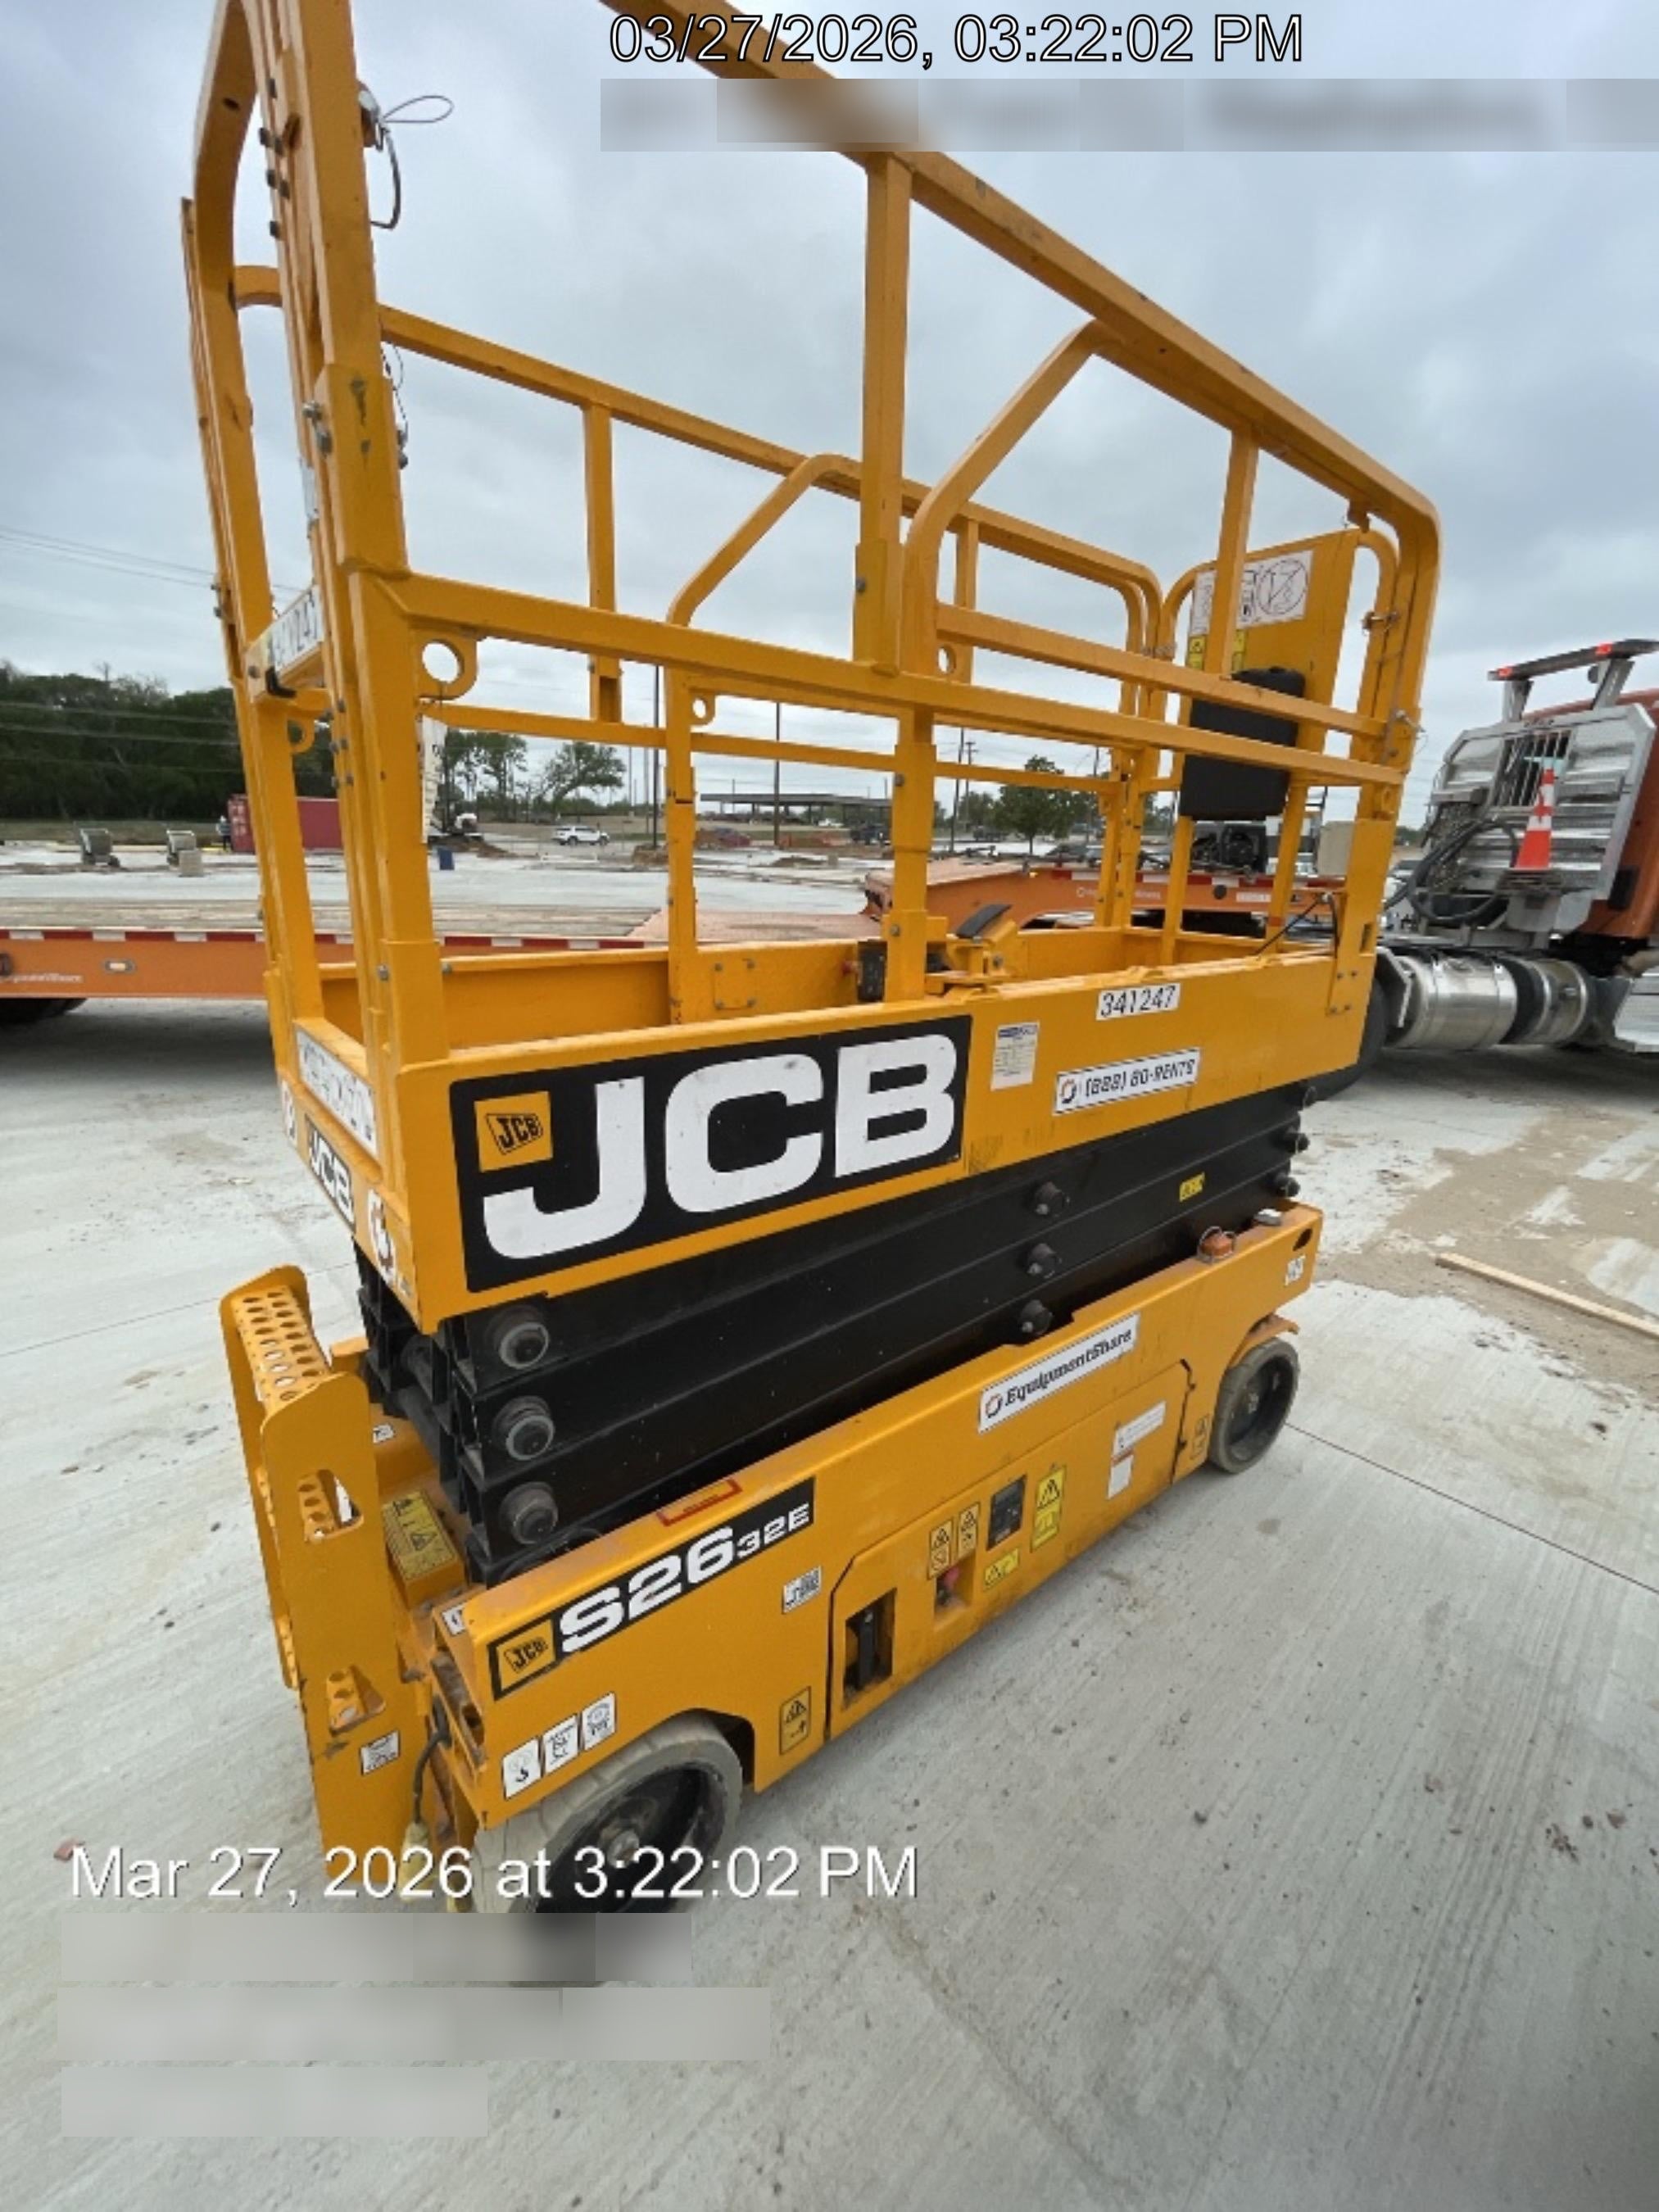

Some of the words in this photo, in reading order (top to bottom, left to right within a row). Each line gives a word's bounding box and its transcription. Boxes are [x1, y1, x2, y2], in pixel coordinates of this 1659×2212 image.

[1100, 985, 1176, 1018] 341247
[483, 1034, 957, 1260] JCB
[496, 1117, 539, 1149] JCB
[1005, 1328, 1132, 1406] EquipmentShare
[559, 1525, 737, 1653] S26
[737, 1503, 810, 1558] 32E
[511, 1640, 546, 1669] JCB
